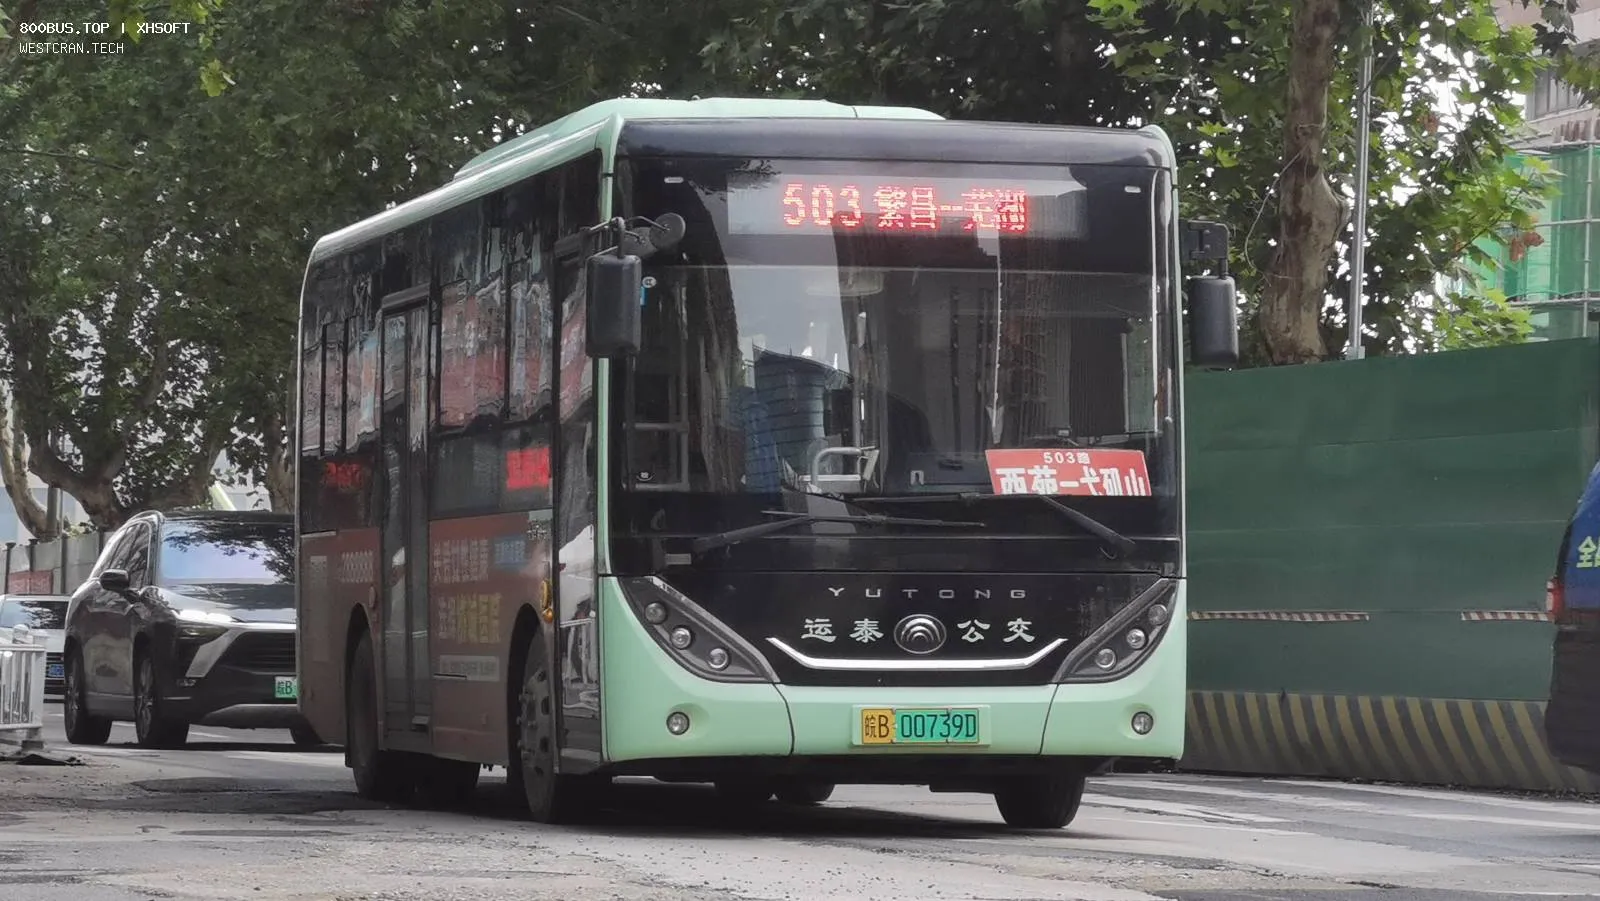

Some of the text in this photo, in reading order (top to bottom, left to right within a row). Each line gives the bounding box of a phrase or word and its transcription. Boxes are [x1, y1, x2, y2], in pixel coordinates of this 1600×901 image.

[784, 183, 862, 227] 503
[828, 587, 1026, 599] YUTONG
[801, 618, 1036, 643] 运泰 公交
